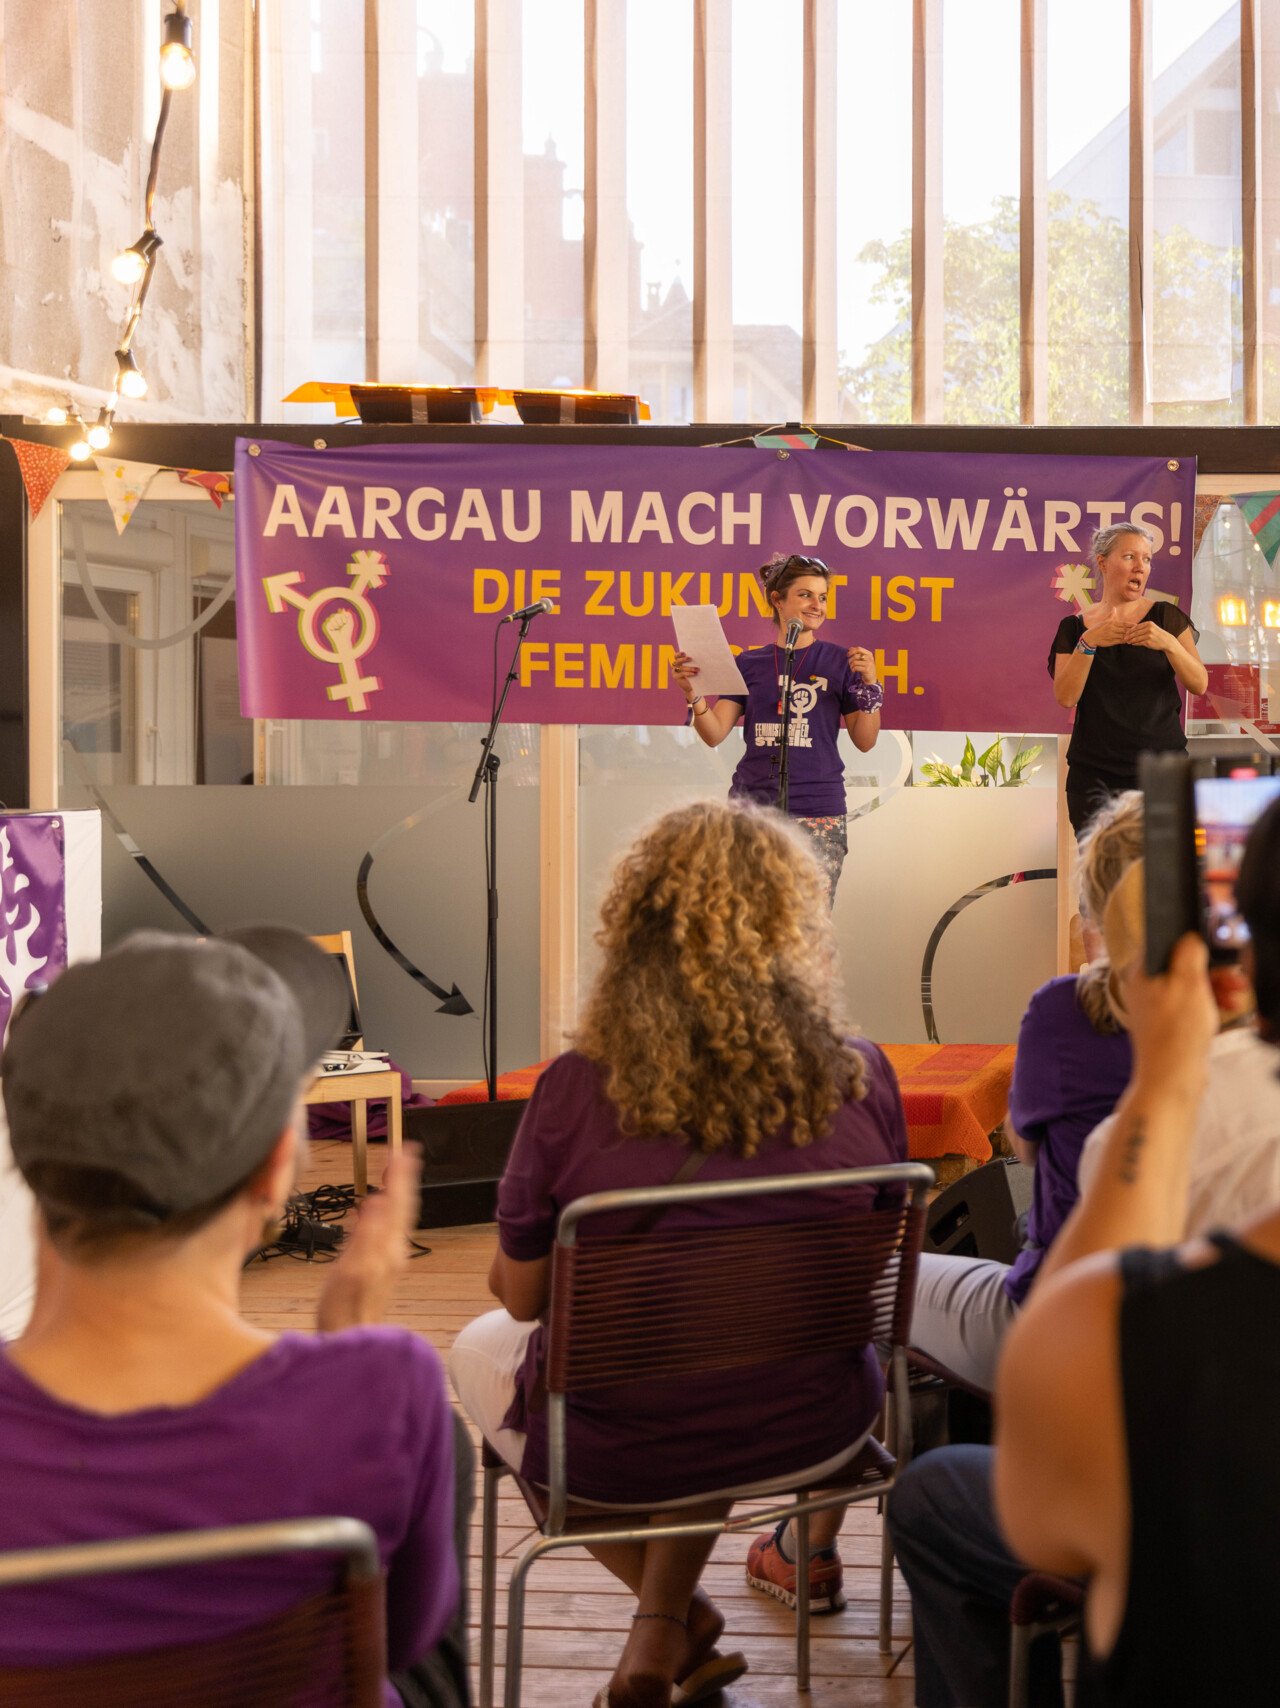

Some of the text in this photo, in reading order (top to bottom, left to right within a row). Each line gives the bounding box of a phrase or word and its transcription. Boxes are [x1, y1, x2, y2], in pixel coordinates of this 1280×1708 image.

[262, 484, 1183, 556] AARGAU MACH VORWÄRTS!
[473, 568, 955, 623] DIE ZUKUNT IST
